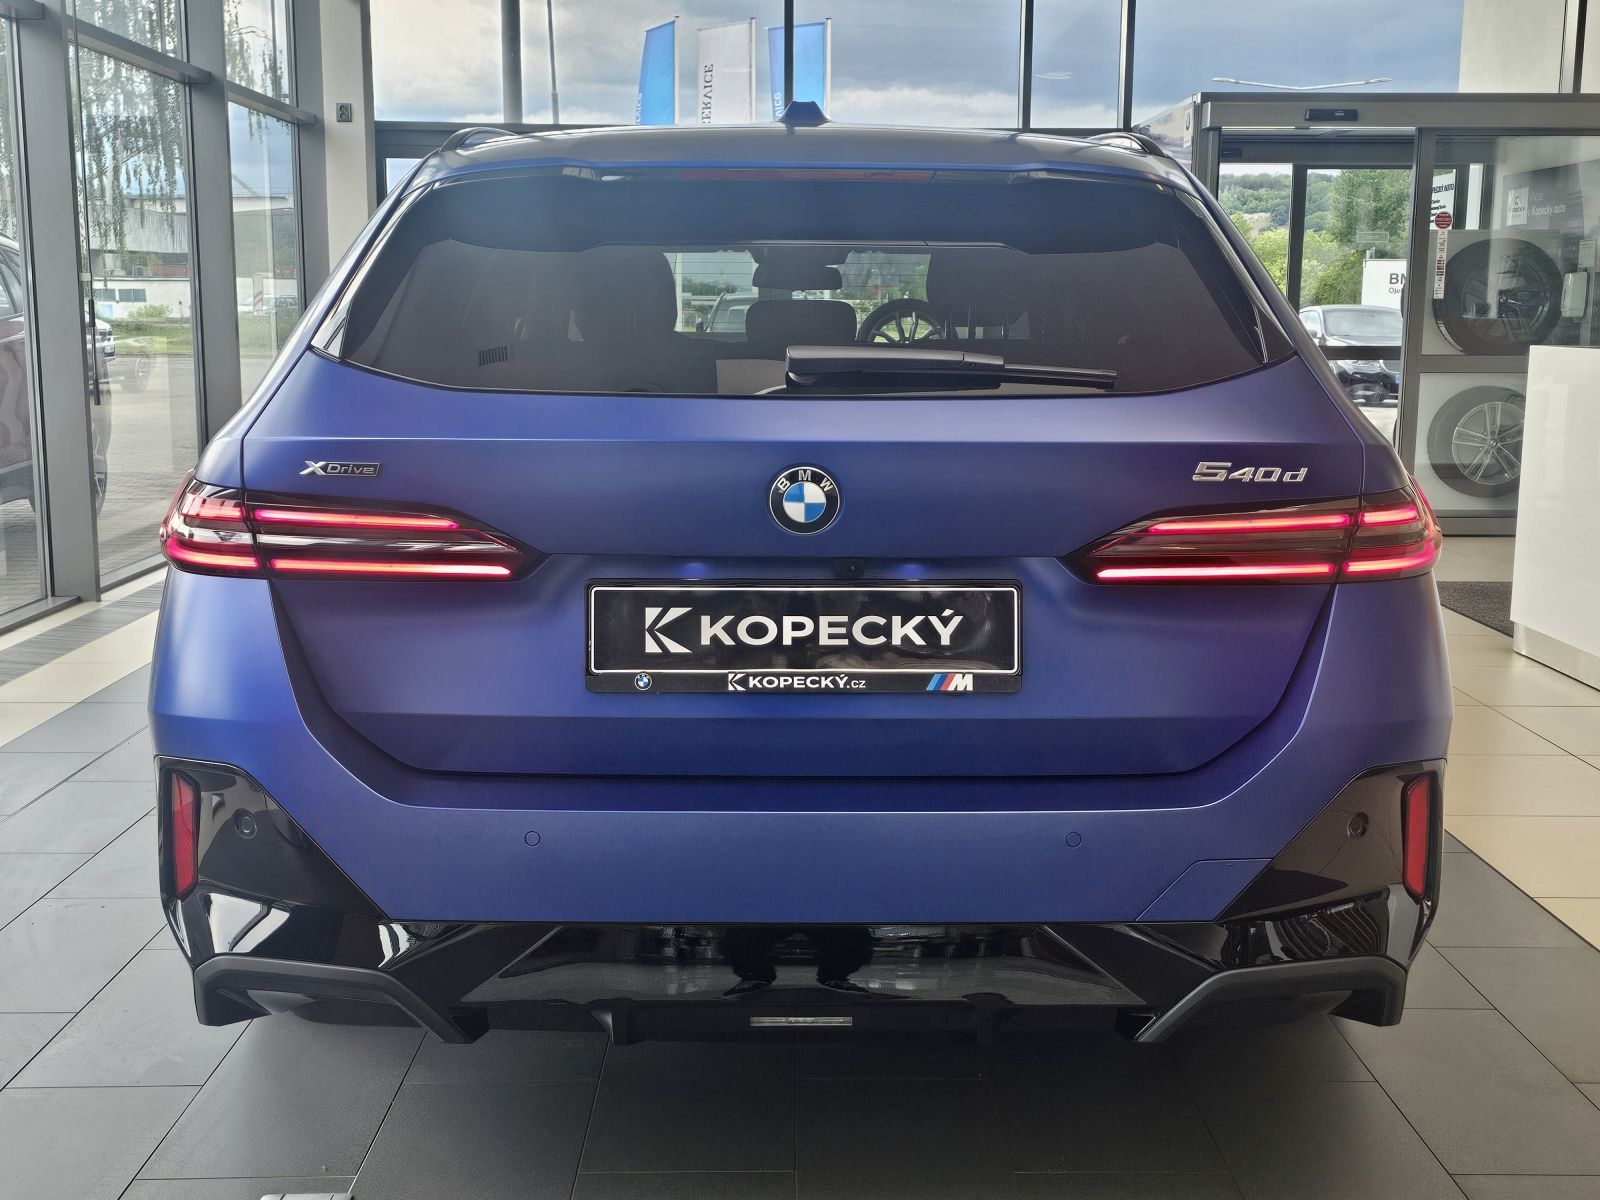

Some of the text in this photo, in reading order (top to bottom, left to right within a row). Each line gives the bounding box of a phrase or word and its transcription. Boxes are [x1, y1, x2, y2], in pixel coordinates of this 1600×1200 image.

[777, 469, 834, 493] BMW
[1192, 461, 1309, 482] 540d
[701, 608, 964, 646] KOPECKÝ
